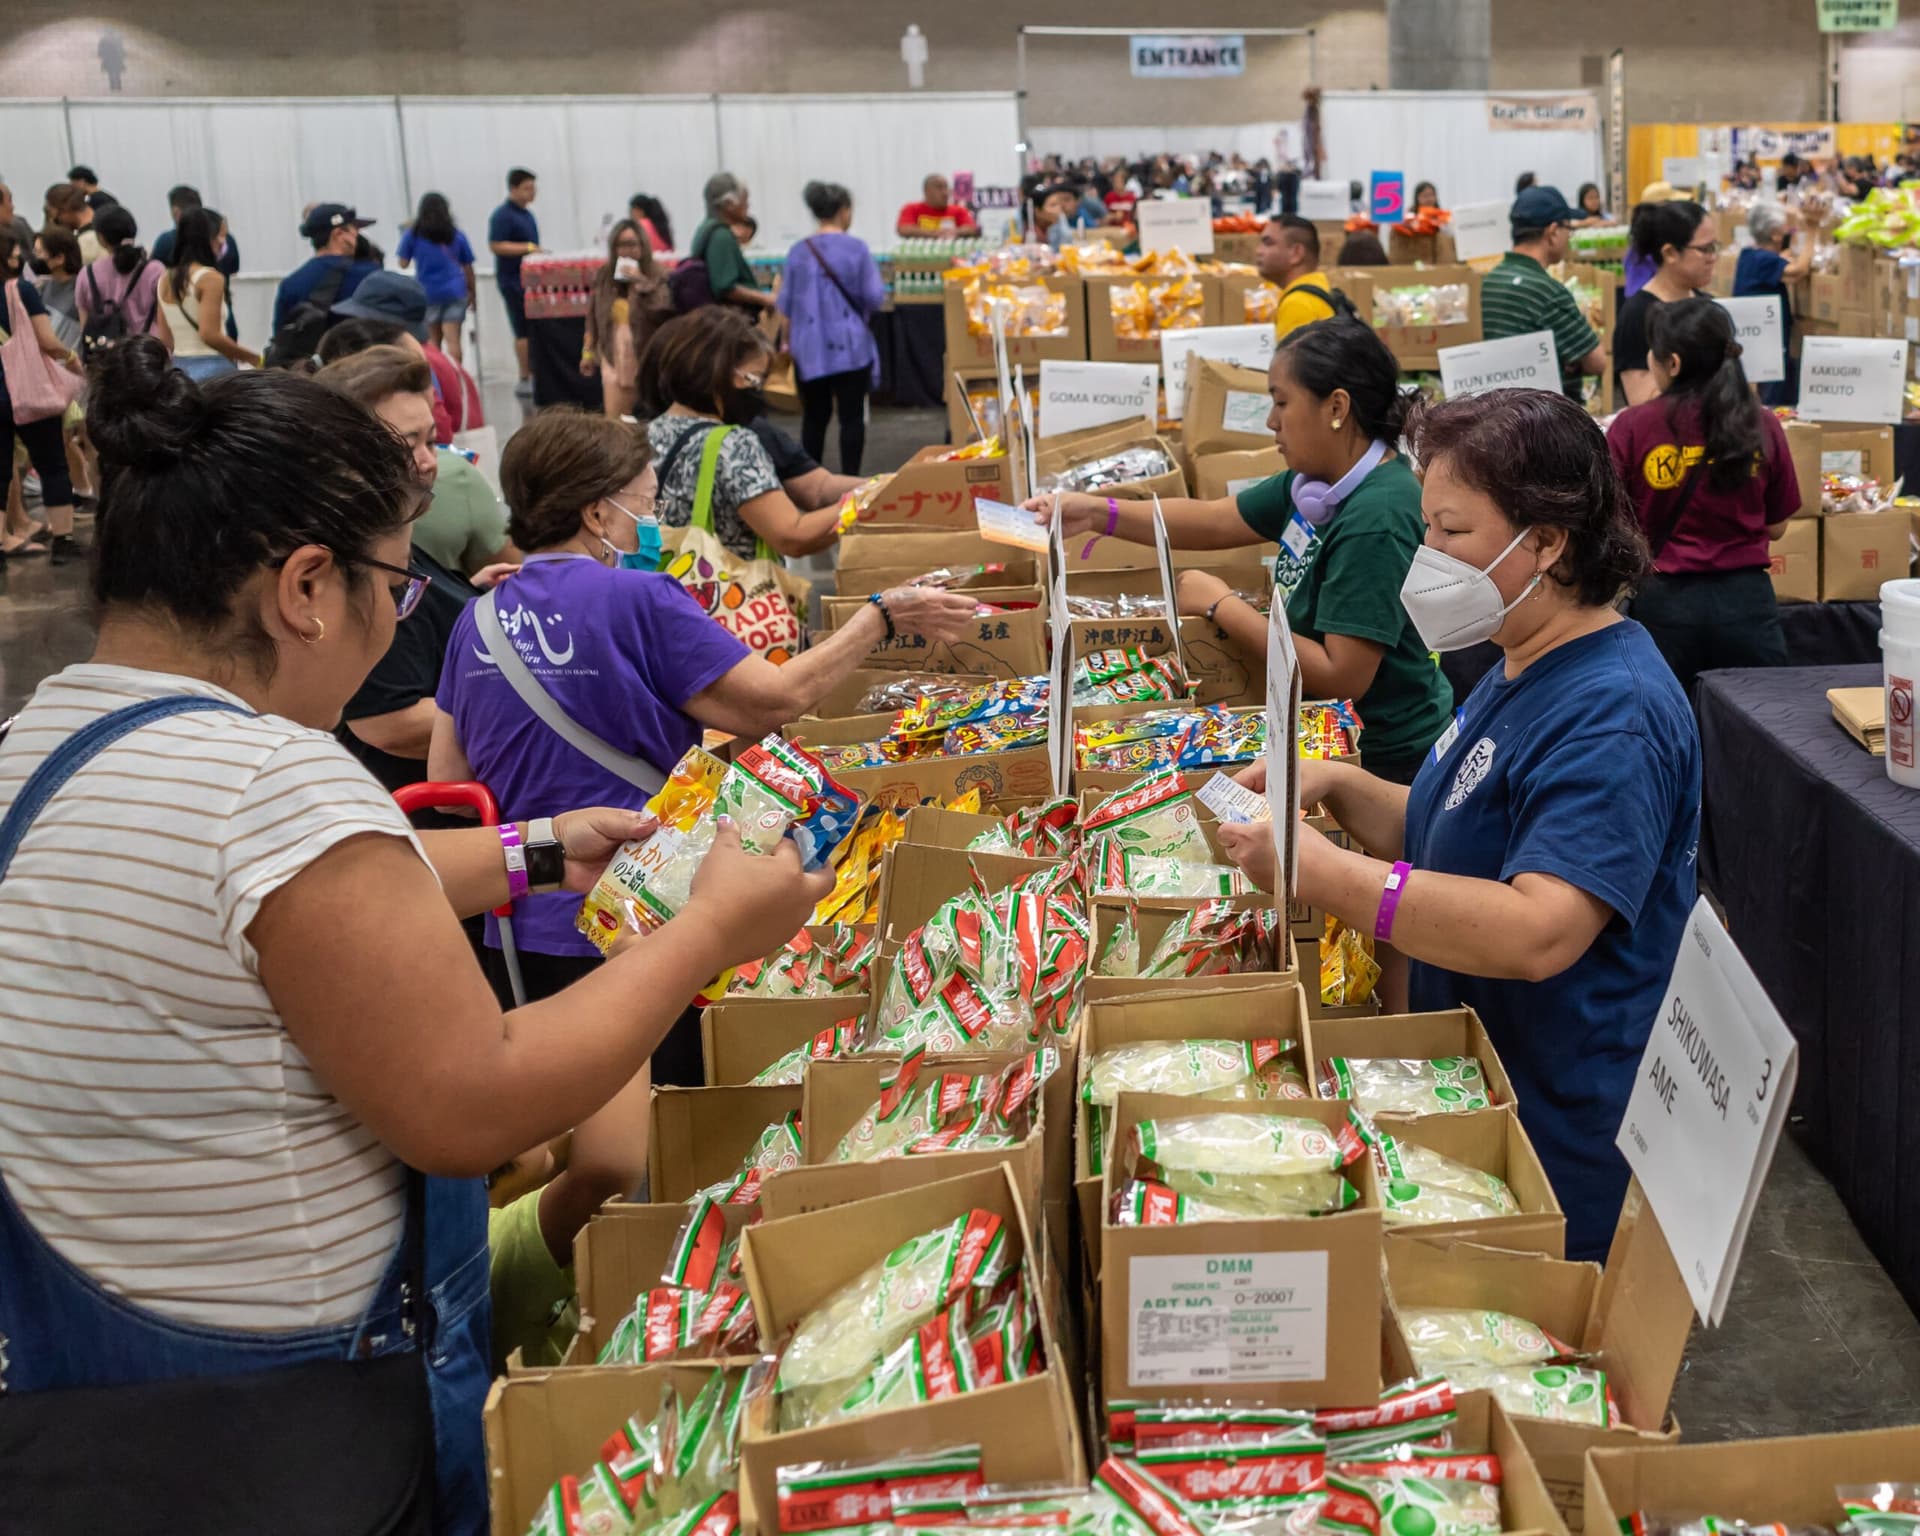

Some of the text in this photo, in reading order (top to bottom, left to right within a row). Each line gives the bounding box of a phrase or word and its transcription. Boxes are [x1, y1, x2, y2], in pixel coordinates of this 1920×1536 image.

[1833, 15, 1881, 27] STORE
[1138, 48, 1240, 66] ENTRANCE
[1374, 182, 1401, 215] 5
[1766, 305, 1775, 319] 5
[1260, 333, 1270, 348] 5
[1539, 342, 1549, 356] 5
[1892, 350, 1901, 362] 4
[1486, 366, 1537, 384] KOKUTO
[1811, 366, 1862, 378] KAKUGIRI
[1141, 375, 1151, 389] 4
[1808, 383, 1855, 396] KOKUTO
[1049, 391, 1145, 407] GOMA KOKUTO
[1666, 996, 1732, 1121] SHIKUWASA
[1648, 1055, 1677, 1115] AME
[1756, 1057, 1773, 1102] 3
[1206, 1259, 1254, 1274] DMM
